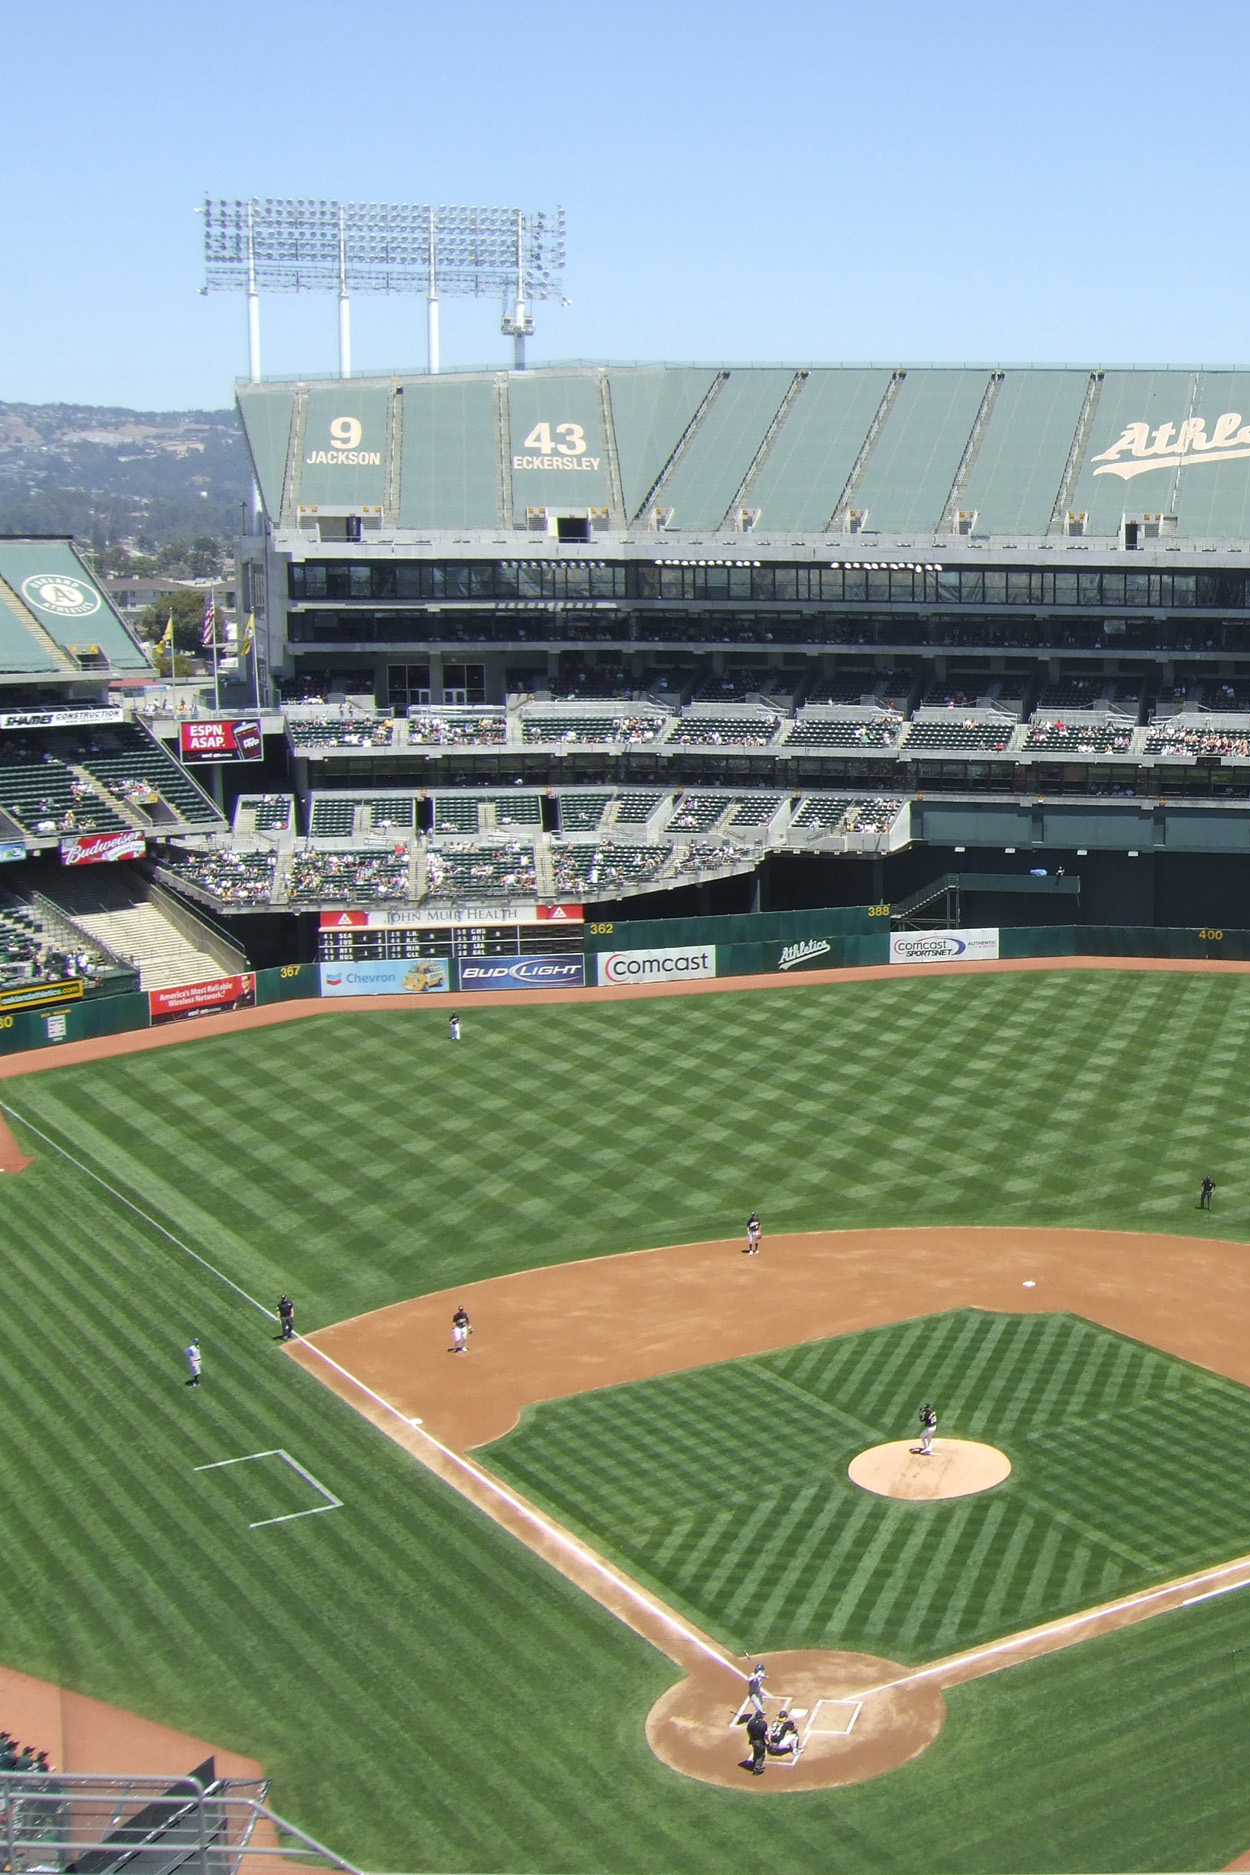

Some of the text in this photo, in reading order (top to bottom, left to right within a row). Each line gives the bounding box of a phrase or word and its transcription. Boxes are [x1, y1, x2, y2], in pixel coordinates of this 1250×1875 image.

[330, 417, 362, 449] 9
[523, 422, 587, 456] 43
[306, 450, 380, 465] JACKSON
[513, 456, 600, 471] ECKERSLEY
[29, 577, 80, 589] OAKLAND
[42, 601, 95, 614] ATHLETICS
[4, 709, 120, 726] SHAMES CONSTRUCTION
[189, 724, 225, 737] ESPN.
[190, 736, 226, 749] ASAP.
[63, 831, 141, 865] Budweiser
[384, 908, 517, 924] JOHN MUIR HEALTH
[868, 906, 890, 917] 388
[590, 924, 613, 935] 362
[1199, 930, 1223, 940] 400
[898, 940, 947, 951] comcast
[778, 939, 830, 969] Athletics
[906, 949, 953, 957] SPORTSNET
[613, 953, 708, 976] comcast
[280, 965, 300, 979] 367
[346, 973, 396, 984] Chevron
[462, 965, 582, 979] BUD LIGHT
[2, 986, 79, 1005] oaklandathletics.com
[159, 982, 233, 1001] America's Most Reliable
[167, 997, 194, 1007] Wireless
